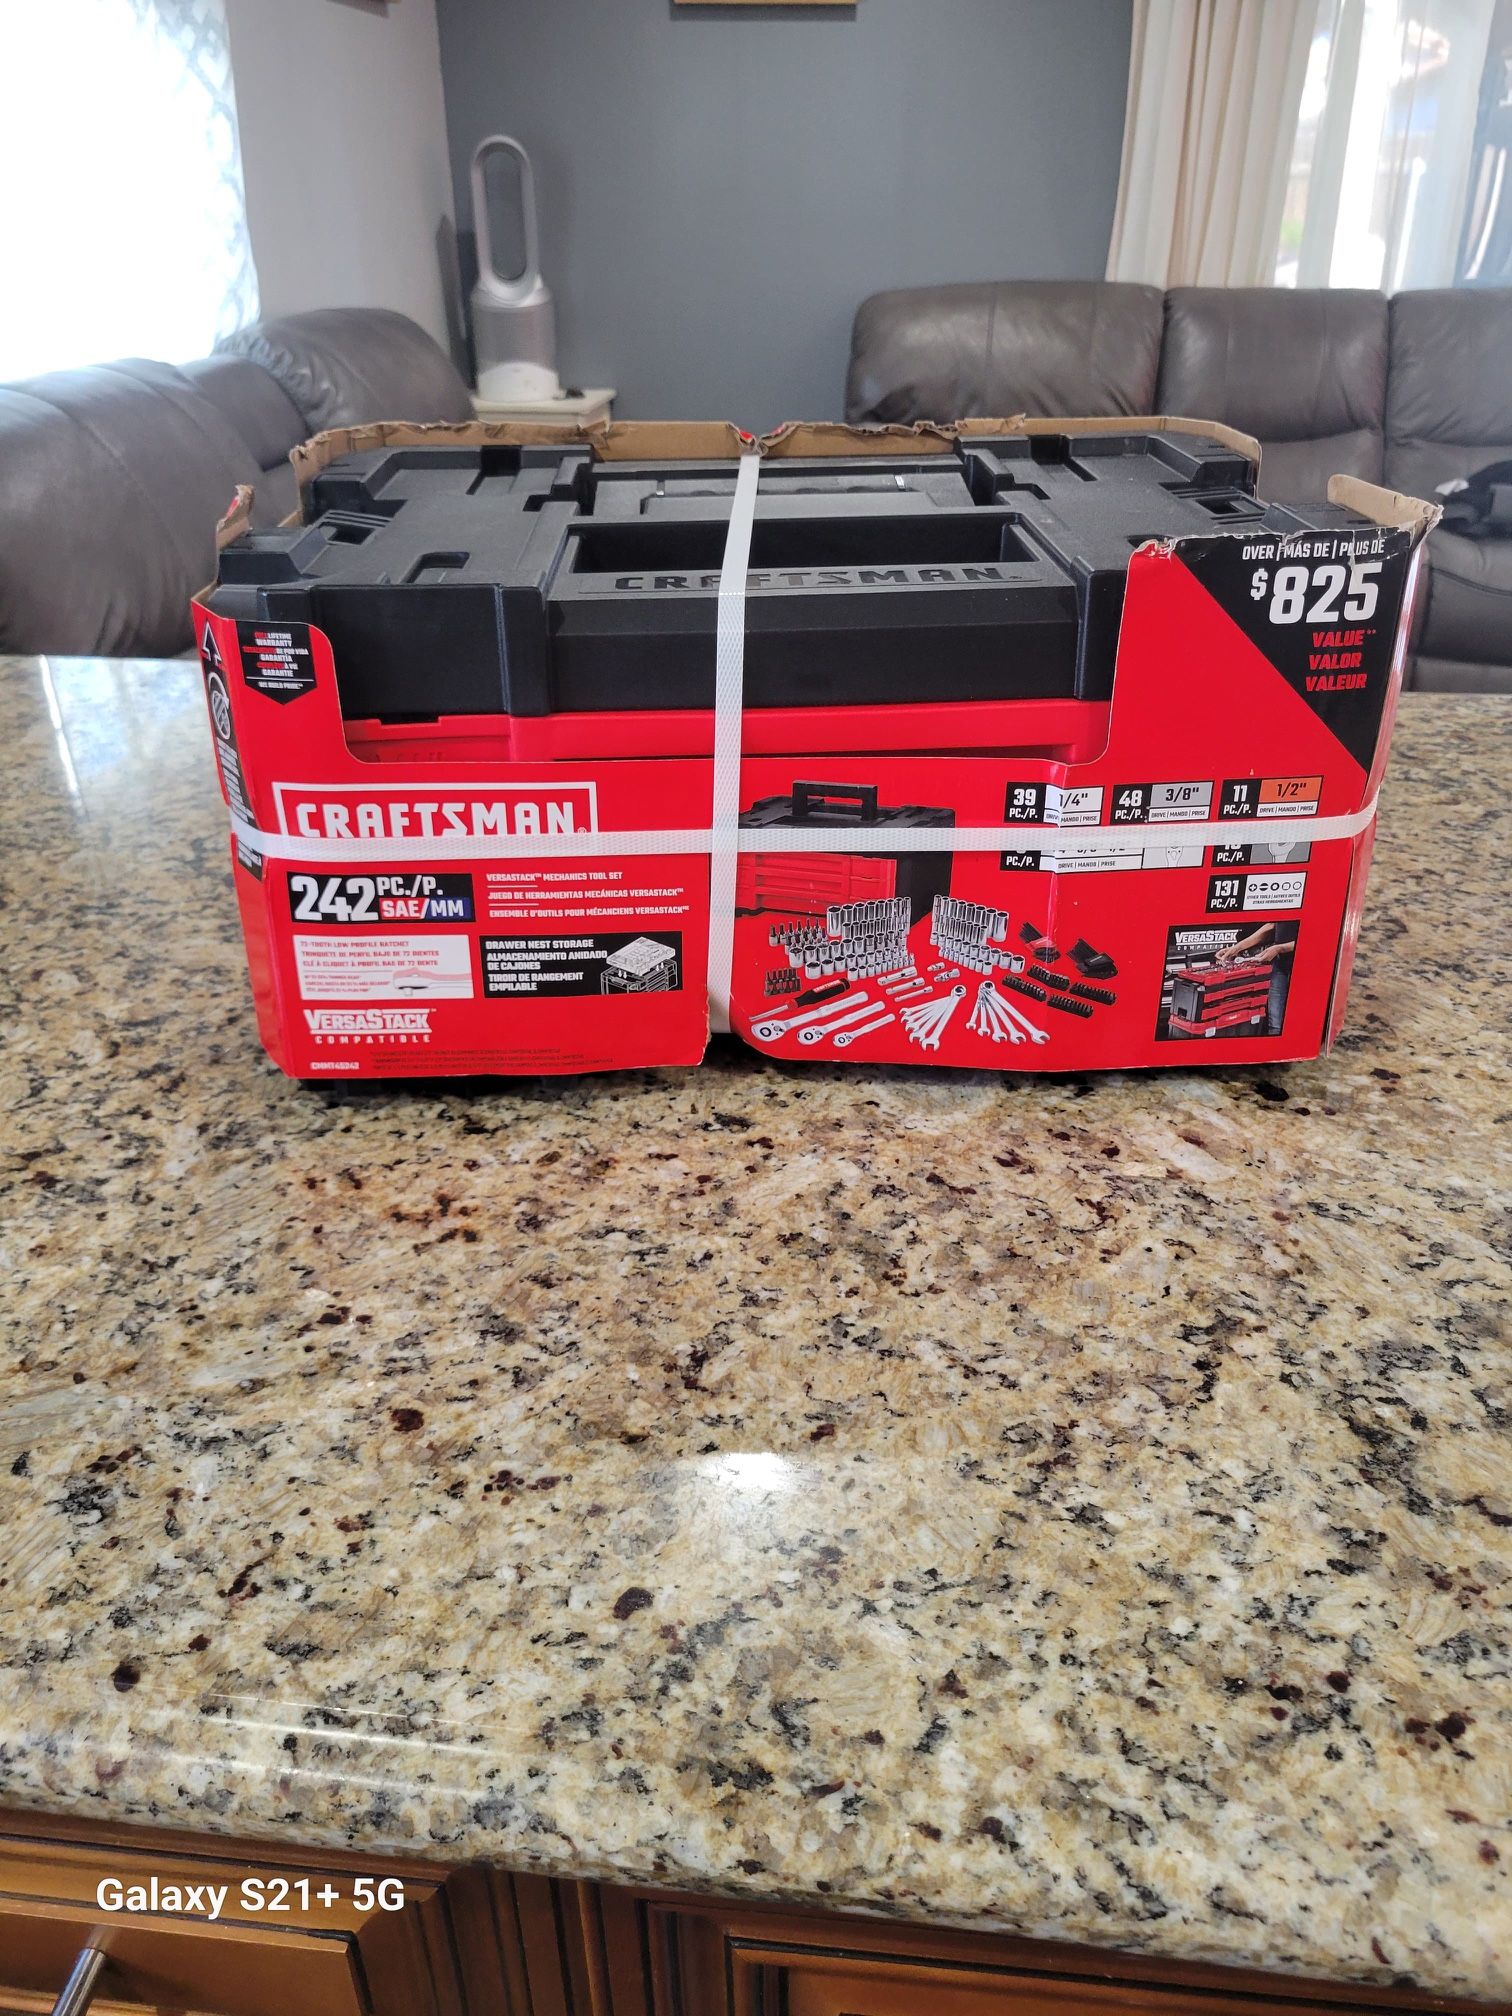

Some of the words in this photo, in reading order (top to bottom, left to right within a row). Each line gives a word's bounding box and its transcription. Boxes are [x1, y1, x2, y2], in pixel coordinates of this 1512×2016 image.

[1242, 545, 1274, 560] OVER
[1284, 540, 1311, 558] MÁS
[1313, 542, 1330, 558] DE
[1339, 540, 1368, 557] PLUS
[1371, 539, 1386, 554] DE
[615, 567, 1001, 590] CRAFTSMAN
[1250, 562, 1382, 624] $825
[1309, 653, 1362, 670] VALOR
[1305, 674, 1368, 691] VALEUR
[1165, 786, 1199, 802] 3/8"
[1233, 785, 1248, 802] 11
[1277, 782, 1307, 797] 1/2"
[1013, 788, 1036, 806] 39
[1118, 790, 1143, 807] 48
[1009, 808, 1038, 819] PC./P.
[1115, 808, 1143, 820] PC./P.
[1223, 804, 1252, 815] PC./P.
[1006, 855, 1035, 867] PC./P.
[1217, 851, 1245, 862] PC./P.
[543, 872, 588, 881] MECHANICS
[589, 872, 608, 880] TOOL
[609, 871, 623, 880] SET
[525, 891, 583, 899] HERRAMIENTAS
[585, 889, 628, 898] MECÁNICAS
[1214, 880, 1239, 896] 131
[290, 875, 379, 922] 242
[376, 875, 443, 898] PC./P.
[1211, 897, 1238, 909] PC./P.
[382, 898, 464, 920] SAE/MM
[490, 909, 529, 918] ENSEMBLE
[565, 908, 585, 917] POUR
[486, 940, 526, 950] DRAWER
[528, 940, 551, 949] NEST
[552, 939, 594, 949] STORAGE
[486, 952, 567, 961] ALMACENAMIENTO
[568, 951, 608, 960] ANIDADO
[488, 962, 500, 971] DE
[500, 961, 541, 970] CAJONES
[488, 973, 517, 982] TIROIR
[518, 973, 530, 982] DE
[531, 972, 584, 981] RANGEMENT
[489, 983, 537, 992] EMPILABLE
[315, 1035, 431, 1044] COMPATIBLE
